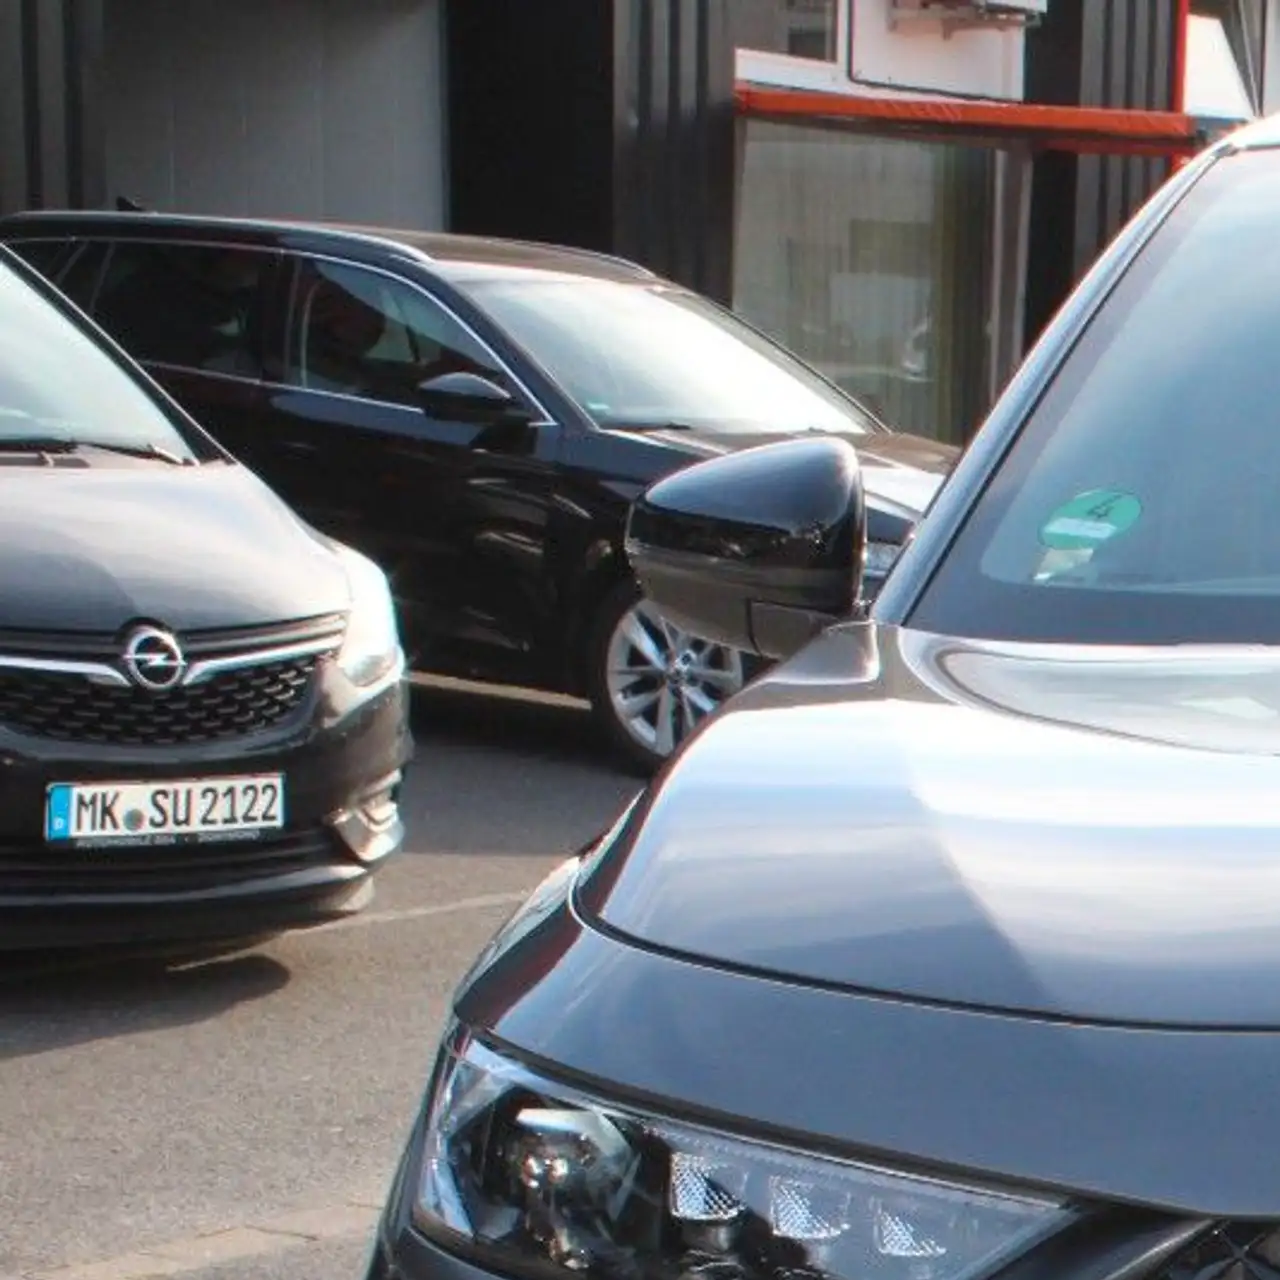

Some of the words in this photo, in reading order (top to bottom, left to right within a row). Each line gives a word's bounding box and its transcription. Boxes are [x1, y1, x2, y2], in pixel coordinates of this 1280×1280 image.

[75, 791, 120, 831] MK
[149, 788, 193, 828] SU
[200, 784, 279, 825] 2122
